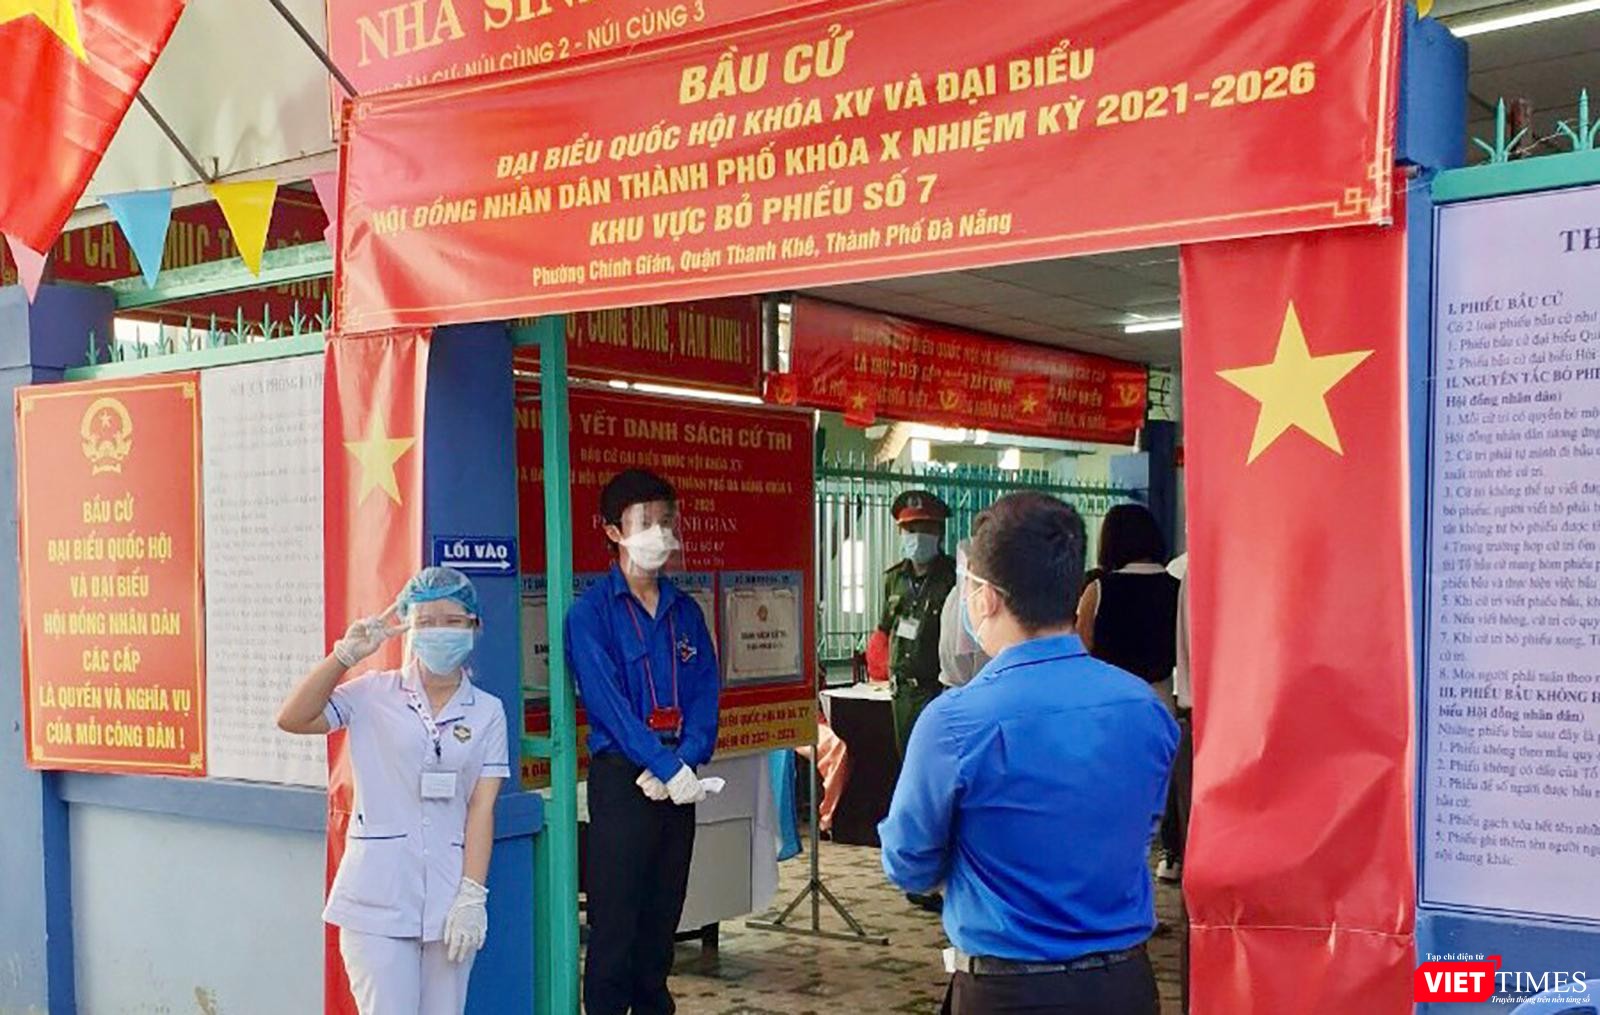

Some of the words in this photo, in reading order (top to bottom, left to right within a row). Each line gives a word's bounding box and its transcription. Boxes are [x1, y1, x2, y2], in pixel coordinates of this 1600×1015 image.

[559, 37, 570, 60] 2
[587, 18, 619, 51] NÚI
[626, 5, 688, 40] CÙNG
[693, 0, 705, 22] 3
[678, 45, 769, 104] BẦU
[782, 23, 854, 86] CỬ
[496, 150, 537, 181] ĐẠI
[543, 131, 603, 172] BIỂU
[608, 119, 681, 161] QUỐC
[688, 113, 737, 149] HỘI
[743, 97, 823, 137] KHÓA
[832, 87, 875, 121] XV
[884, 72, 928, 112] VÀ
[936, 64, 997, 105] ĐẠI
[1008, 38, 1096, 92] BIỂU
[482, 185, 552, 220] NHÂN
[557, 175, 612, 210] DÂN
[617, 162, 710, 202] THÀNH
[716, 141, 777, 187] PHỐ
[784, 134, 870, 177] KHÓA
[879, 130, 903, 162] X
[912, 110, 1028, 157] NHIỆM
[1036, 93, 1087, 136] KỲ
[1095, 61, 1317, 127] 2021-2026
[588, 215, 646, 247] KHU
[652, 205, 707, 243] VỰC
[713, 192, 754, 232] BỎ
[761, 179, 854, 226] PHIẾU
[862, 166, 908, 211] SỐ
[916, 172, 939, 204] 7
[885, 217, 925, 248] Phố
[1460, 295, 1504, 315] PHIẾU
[623, 417, 679, 442] DANH
[684, 421, 734, 448] SÁCH
[767, 431, 793, 451] TRI
[107, 528, 145, 562] QUỐC
[148, 531, 172, 564] HỘI
[443, 538, 471, 560] LỐI
[473, 541, 508, 560] VÀO
[82, 645, 110, 673] CÁC
[1460, 682, 1500, 701] PHIẾU
[1536, 686, 1588, 704] KHÔNG
[1566, 671, 1594, 684] theo
[172, 688, 192, 718] VỤ
[105, 719, 143, 748] CÔNG
[179, 726, 186, 750] !
